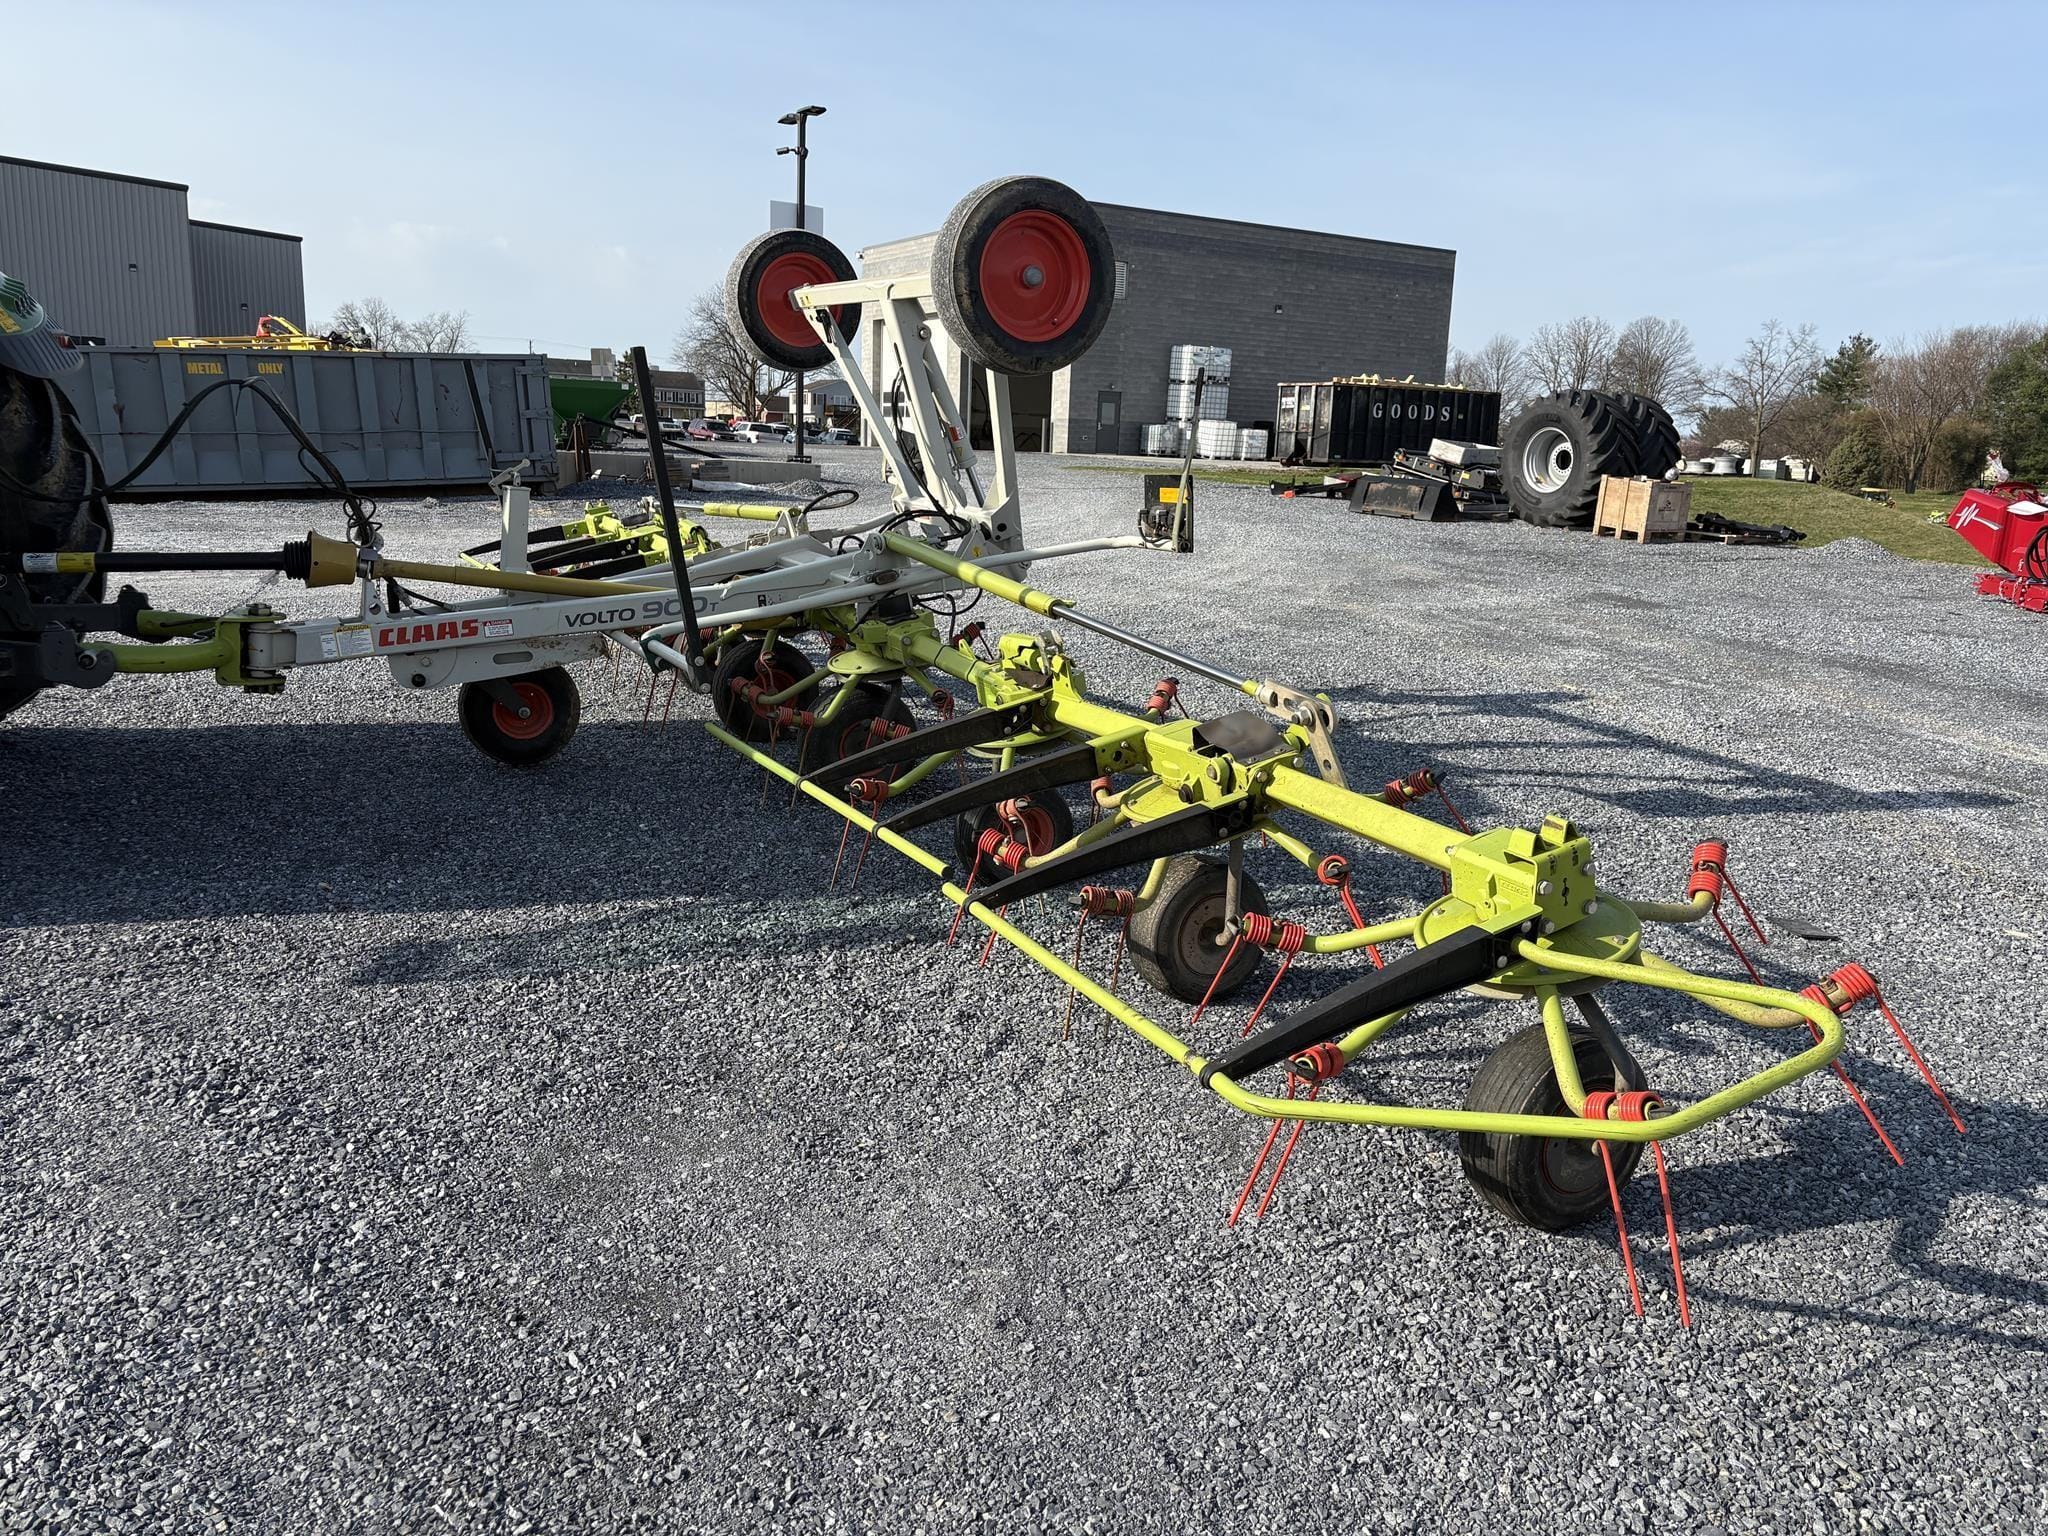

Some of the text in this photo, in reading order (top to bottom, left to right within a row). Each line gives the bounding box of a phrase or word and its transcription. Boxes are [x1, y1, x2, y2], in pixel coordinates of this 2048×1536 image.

[186, 362, 284, 374] METAL ONLY
[1372, 402, 1451, 422] GOODS
[565, 608, 636, 627] VOLTO
[378, 619, 478, 647] CLAAS
